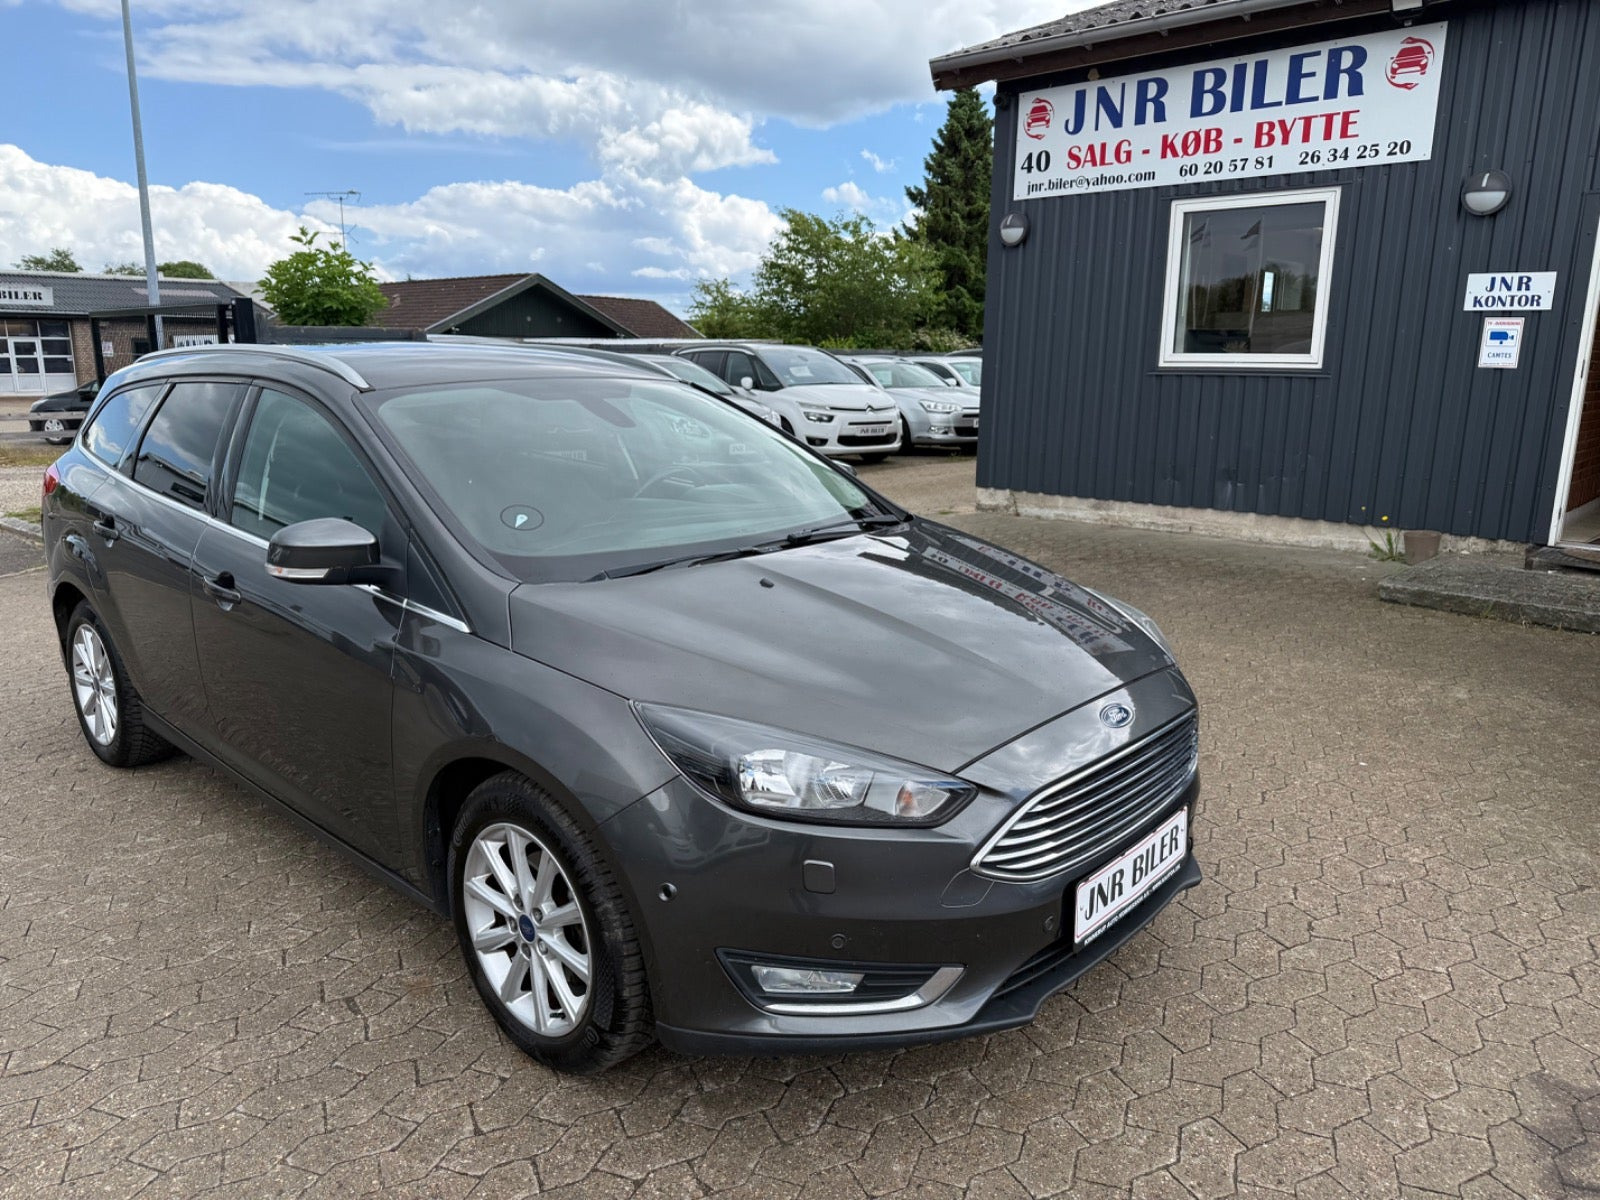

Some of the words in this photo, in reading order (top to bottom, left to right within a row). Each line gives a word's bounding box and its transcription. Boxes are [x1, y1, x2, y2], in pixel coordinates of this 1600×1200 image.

[1064, 76, 1169, 136] JNR
[1189, 45, 1368, 118] BILER
[1066, 139, 1132, 170] SALG
[1160, 126, 1224, 160] KØB
[1253, 109, 1360, 149] BYTTE
[1020, 149, 1051, 174] 40
[1179, 163, 1198, 177] 60
[1203, 160, 1223, 175] 20
[1228, 157, 1249, 172] 57
[1254, 155, 1274, 169] 81
[1298, 150, 1321, 166] 26
[1327, 147, 1349, 162] 34
[1356, 143, 1380, 160] 25
[1386, 140, 1412, 156] 20
[1026, 170, 1156, 196] jnr.biler@yahoo.com
[1485, 275, 1532, 292] JNR
[1472, 294, 1542, 308] KONTOR
[1084, 868, 1125, 920] JNR
[1131, 824, 1180, 887] BILER
